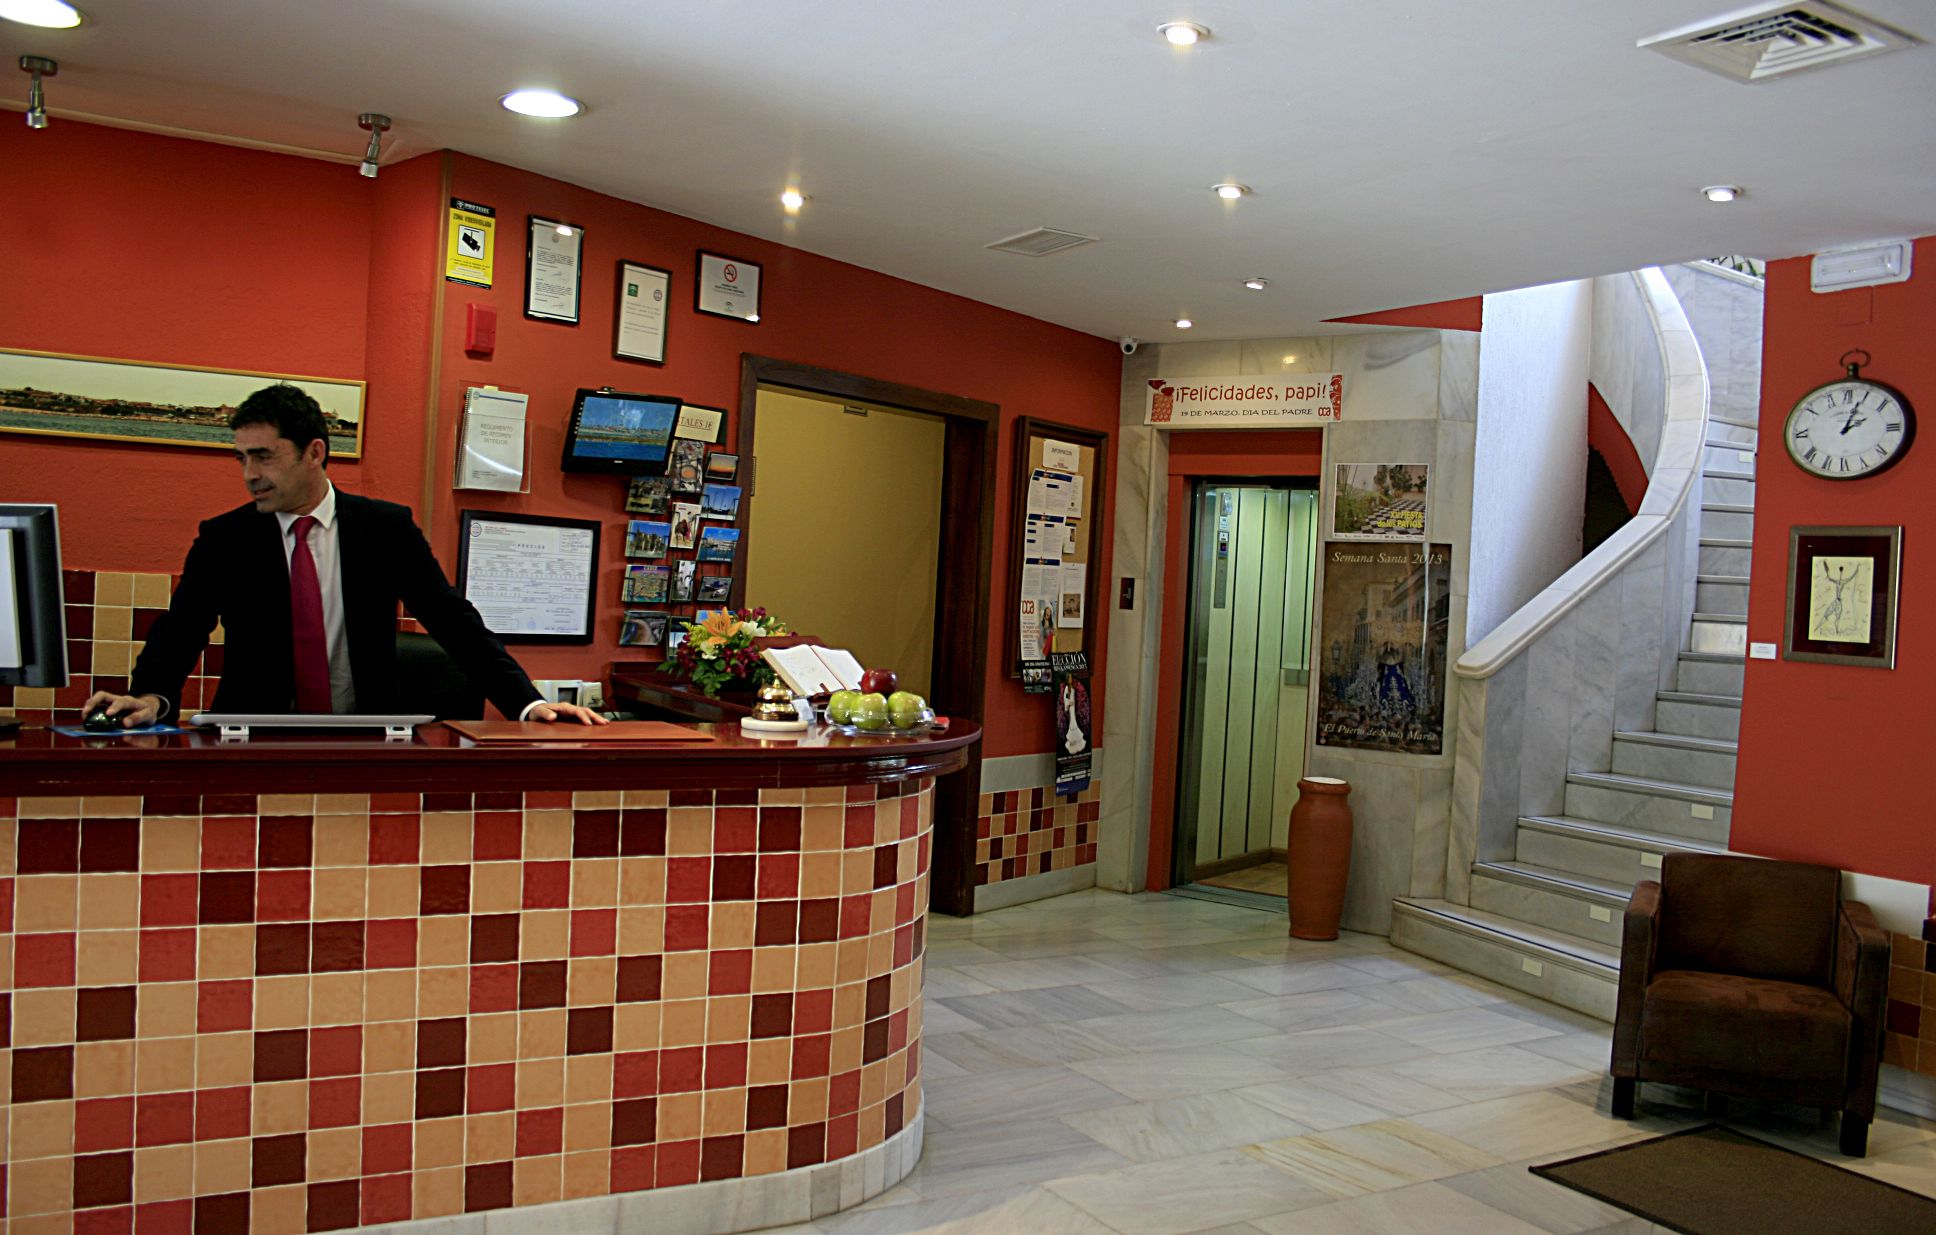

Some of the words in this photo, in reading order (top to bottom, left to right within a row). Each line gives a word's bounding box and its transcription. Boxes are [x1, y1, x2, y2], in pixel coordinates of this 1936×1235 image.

[1175, 385, 1279, 403] ¡Felicidades,
[1285, 383, 1327, 401] papi!
[1282, 408, 1313, 416] PADRE
[679, 416, 704, 428] TALES
[1332, 551, 1373, 563] Semana
[1377, 552, 1408, 564] Santa
